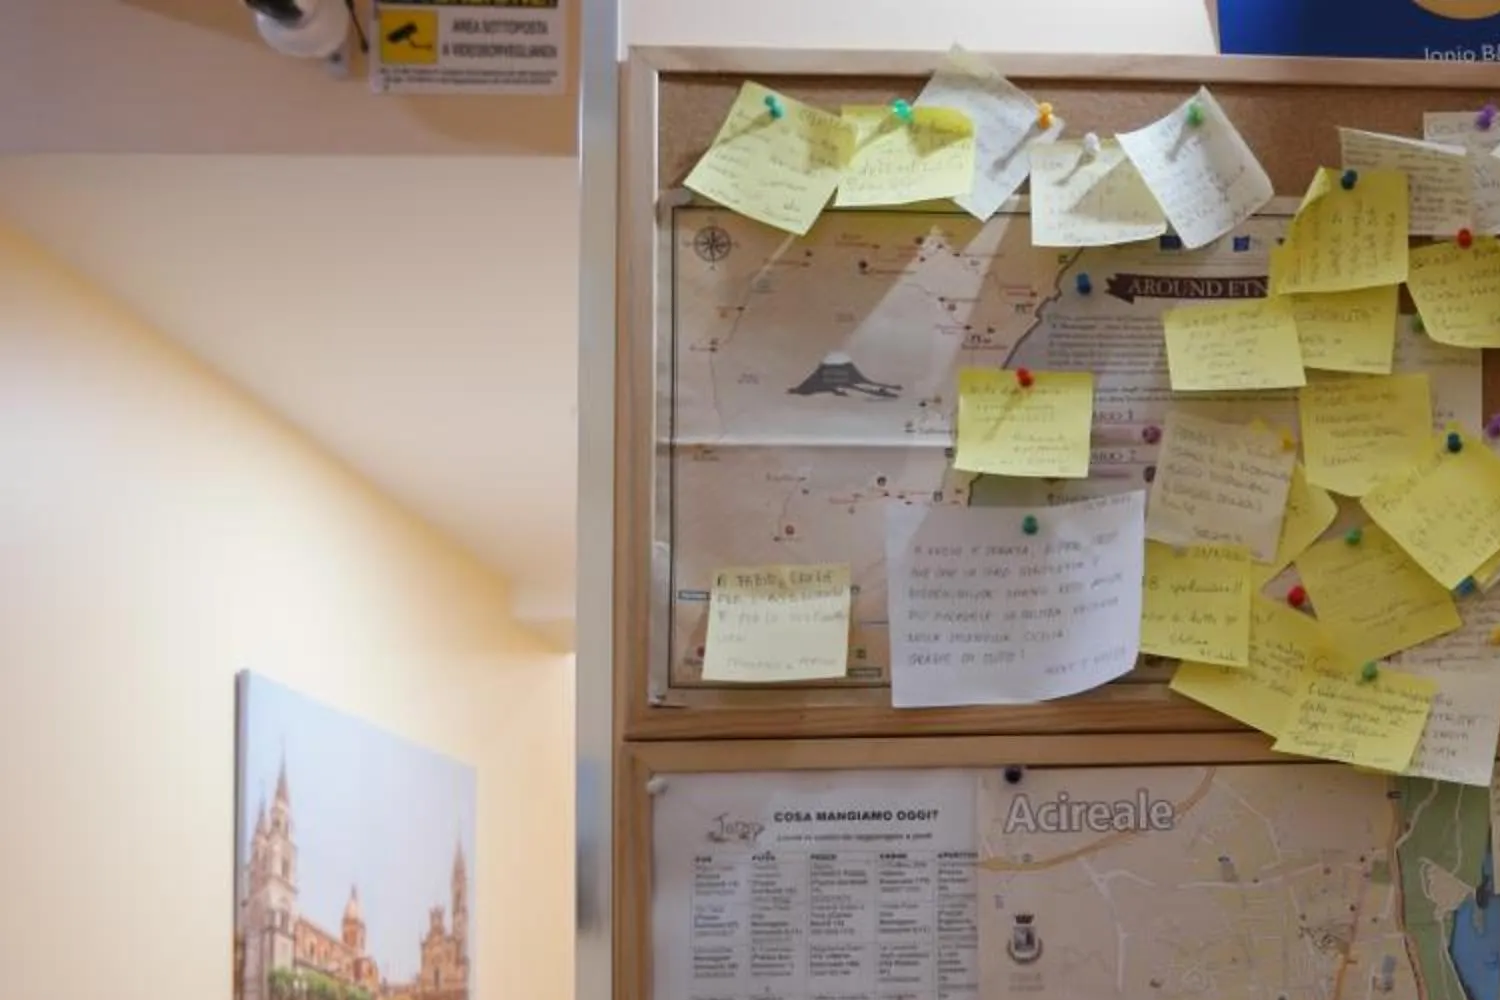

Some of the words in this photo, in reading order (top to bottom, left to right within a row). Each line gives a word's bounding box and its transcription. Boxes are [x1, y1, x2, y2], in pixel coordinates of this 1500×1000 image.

[1129, 279, 1222, 297] AROUND
[1229, 279, 1268, 297] ETN
[773, 811, 812, 823] COSA
[815, 810, 892, 822] MANGIAMO
[896, 809, 939, 821] OGGI?
[1004, 789, 1175, 833] Acireale
